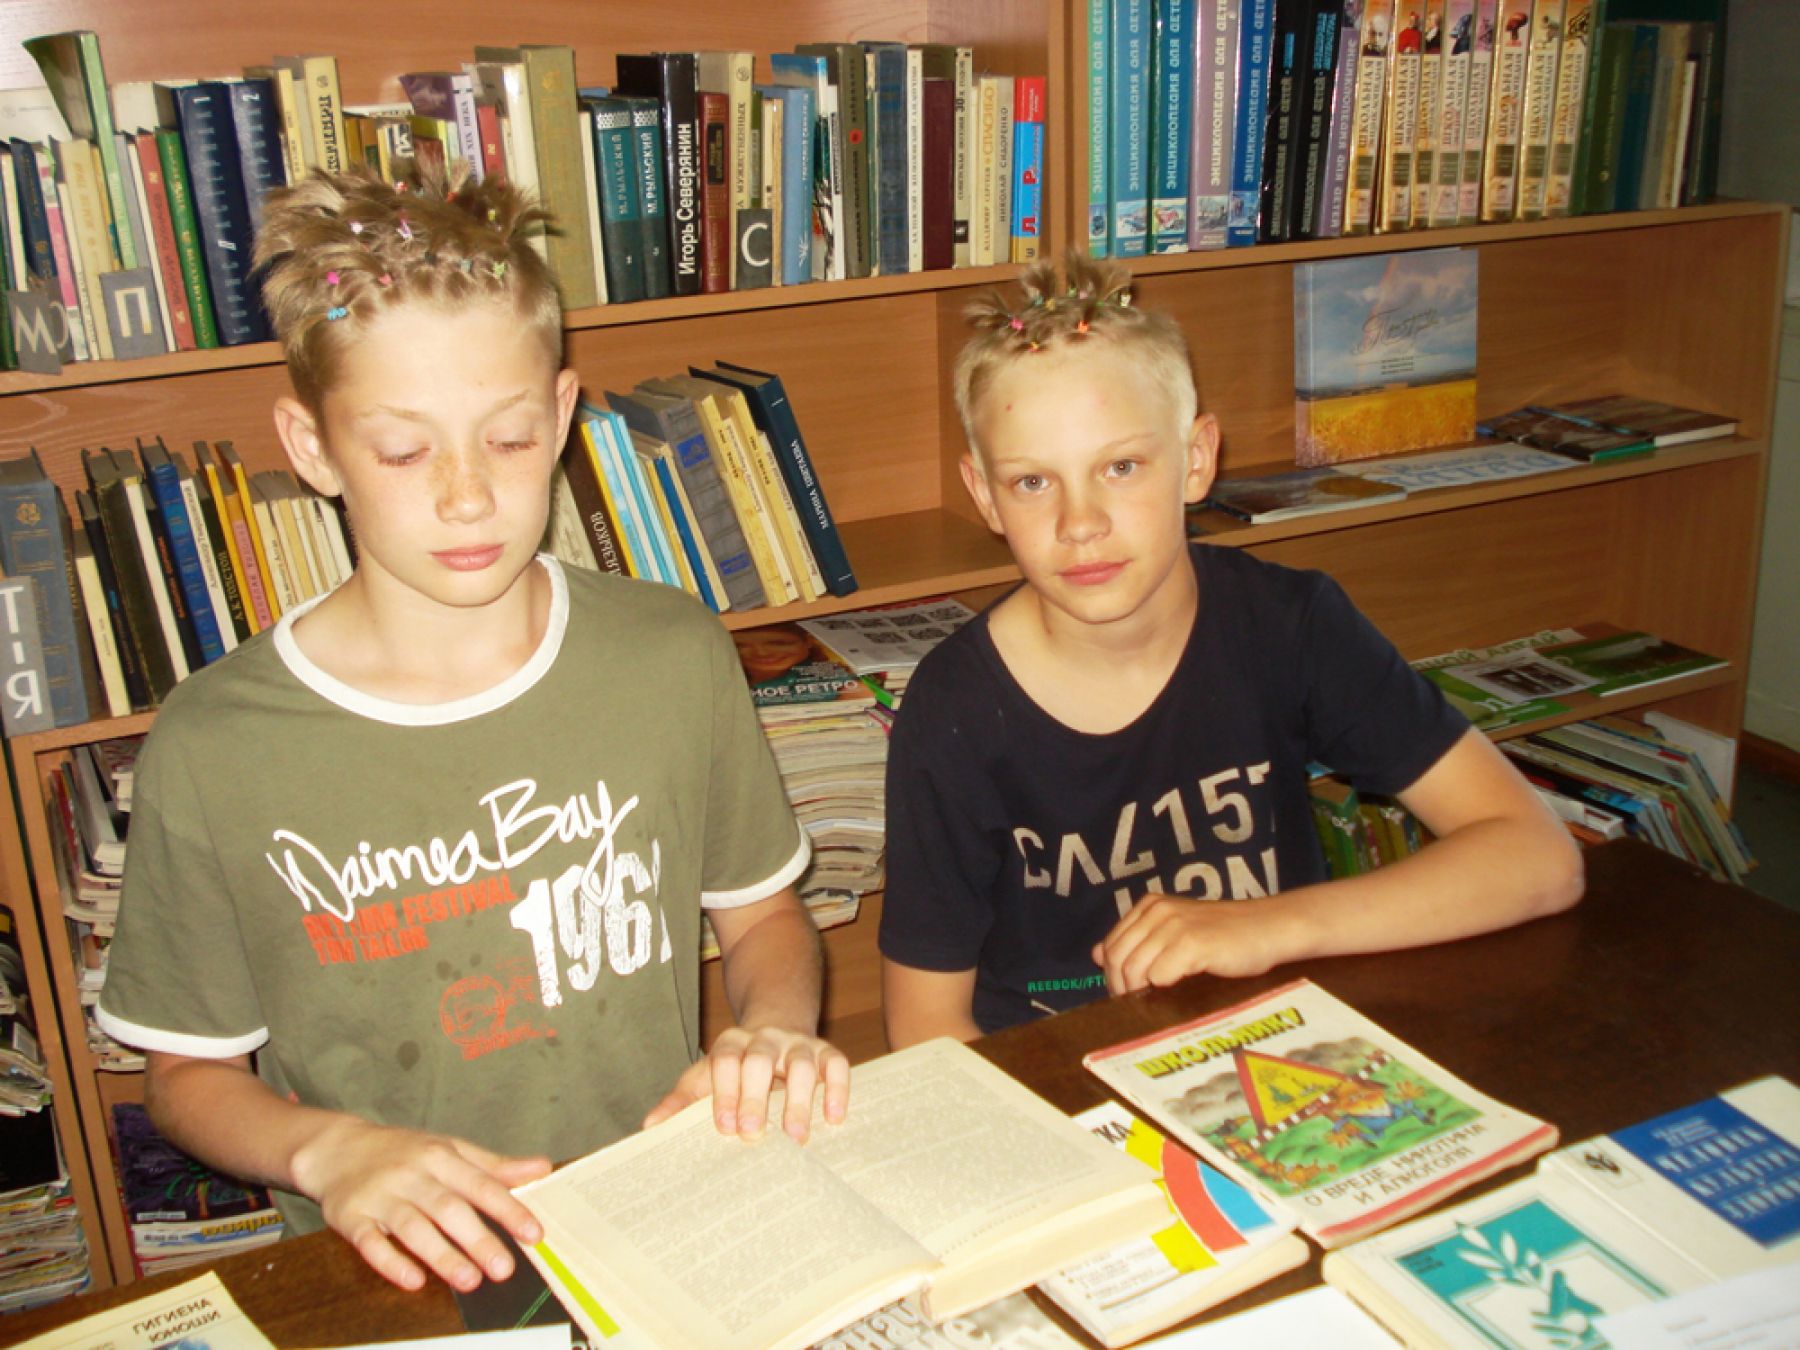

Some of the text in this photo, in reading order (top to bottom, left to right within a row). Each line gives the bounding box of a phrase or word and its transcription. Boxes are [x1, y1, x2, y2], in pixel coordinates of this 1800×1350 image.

[1093, 41, 1104, 70] ДЛЯ
[1129, 39, 1140, 68] ДЛЯ
[1169, 38, 1181, 67] ДЛЯ
[1214, 37, 1225, 65] ДЛЯ
[983, 86, 993, 154] СПАСИБО
[1210, 71, 1225, 186] ЭНЦИКЛОПЕДИЯ
[1243, 0, 1266, 183] ЭНЦИКЛОПЕДИЯ ДЛЯ ДЕТ
[1358, 61, 1374, 148] ШКОЛЬНАЯ
[1395, 56, 1409, 146] ШКОЛЬНАЯ
[1418, 60, 1432, 140] ШКОЛЬНАЯ
[1442, 59, 1456, 145] ШКОЛЬНАЯ
[1465, 64, 1480, 140] ШКОЛЬНАЯ
[1498, 53, 1514, 137] ШКОЛЬНАЯ
[1529, 55, 1544, 138] ШКОЛЬНАЯ
[1557, 54, 1573, 140] ШКОЛЬНАЯ
[999, 107, 1007, 222] НИКОЛАЙ СИДОРЕНКО
[1093, 76, 1104, 194] ЭНЦИКЛОПЕДИЯ
[1129, 74, 1140, 191] ЭНЦИКЛОПЕДИЯ
[1166, 74, 1180, 190] ЭНЦИКЛОПЕДИЯ
[640, 132, 656, 214] М.РЫЛЬСКИЙ
[676, 123, 695, 276] Игорь Северянин
[741, 222, 770, 267] С
[15, 306, 57, 354] М
[114, 287, 152, 338] П
[795, 680, 858, 695] РЕТРО
[266, 778, 640, 922] Waimea Bay
[402, 875, 519, 926] FESTIVAL
[509, 839, 673, 1007] 196
[313, 925, 430, 966] TOM TAILOR
[1027, 975, 1108, 993] REEBOK//FT
[1134, 1007, 1306, 1078] ШКОЛЬНИКУ
[1305, 1122, 1486, 1207] О ВРЕДЕ НИКОТИНА
[1353, 1144, 1476, 1206] И АЛКОГОЛЯ
[132, 1298, 213, 1336] ГИГИЕНА
[149, 1309, 222, 1344] ЮНОШИ
